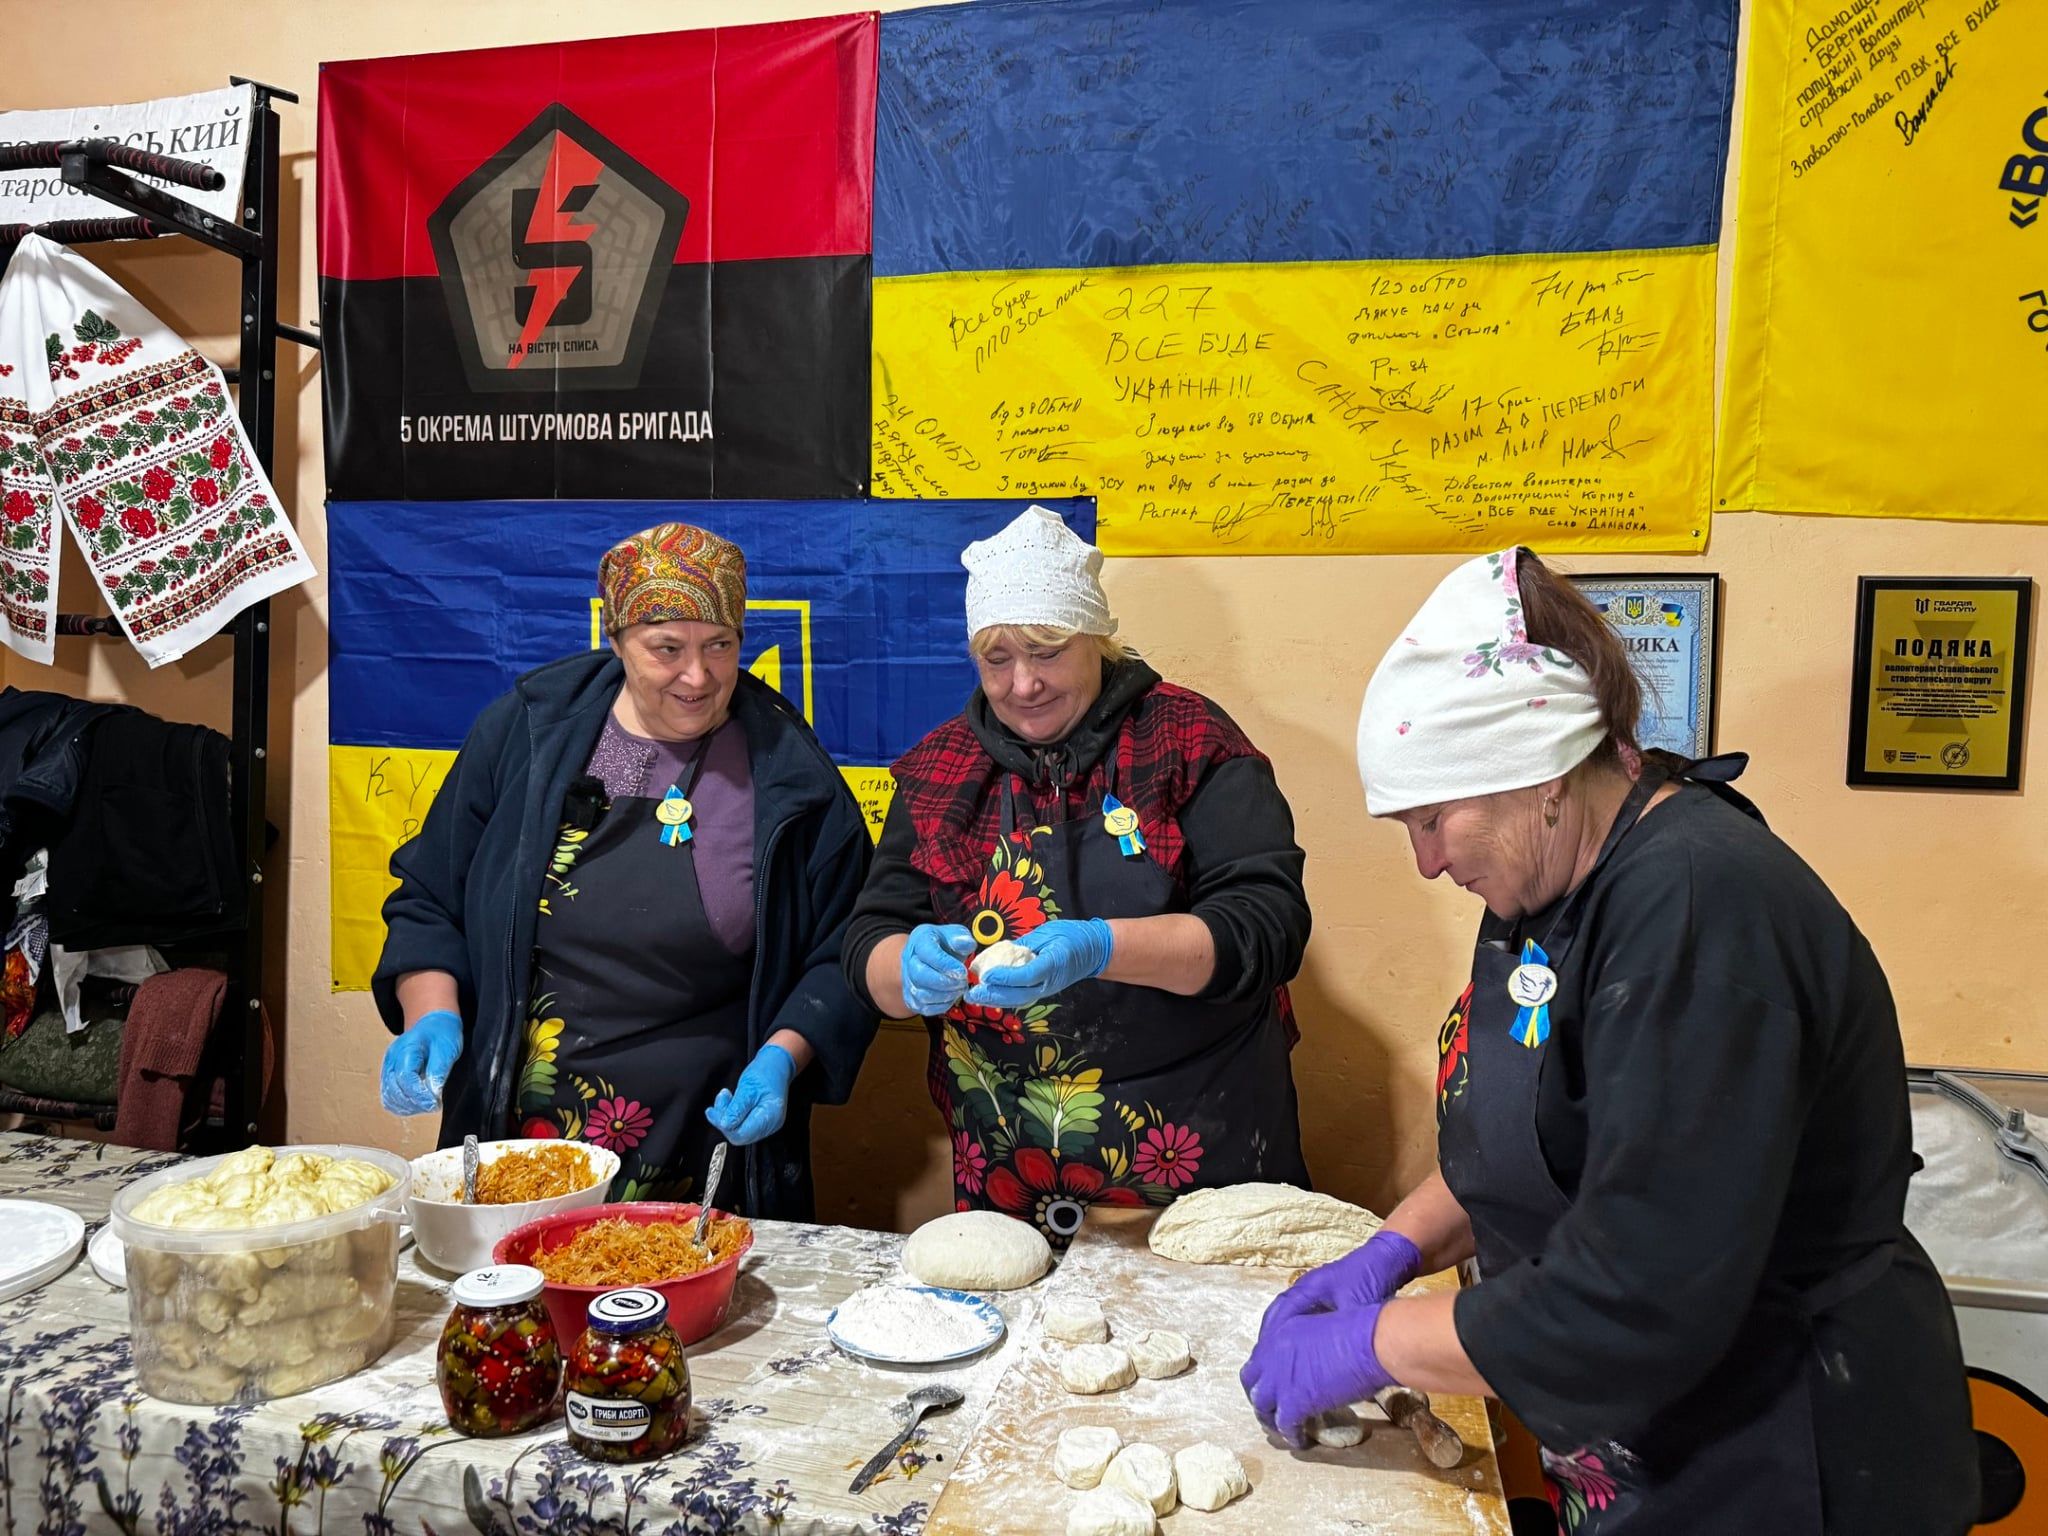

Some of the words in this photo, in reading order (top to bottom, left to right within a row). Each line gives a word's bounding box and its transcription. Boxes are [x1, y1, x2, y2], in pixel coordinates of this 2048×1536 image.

[1104, 285, 1216, 322] 227
[508, 342, 523, 355] НА
[527, 341, 560, 354] ВІСТРІ
[564, 339, 599, 353] СПИСА
[1105, 332, 1184, 365] ВСЕ
[1199, 332, 1275, 358] БУДЕ
[1542, 377, 1645, 423] ПЕРЕМОГИ
[400, 415, 412, 443] 5
[417, 414, 494, 443] ОКРЕМА
[499, 412, 613, 441] ШТУРМОВА
[619, 410, 714, 442] БРИГАДА
[1895, 638, 1992, 659] ПОДЯКА
[595, 1408, 617, 1420] ГРИБИ
[618, 1408, 645, 1420] АСОРТІ
